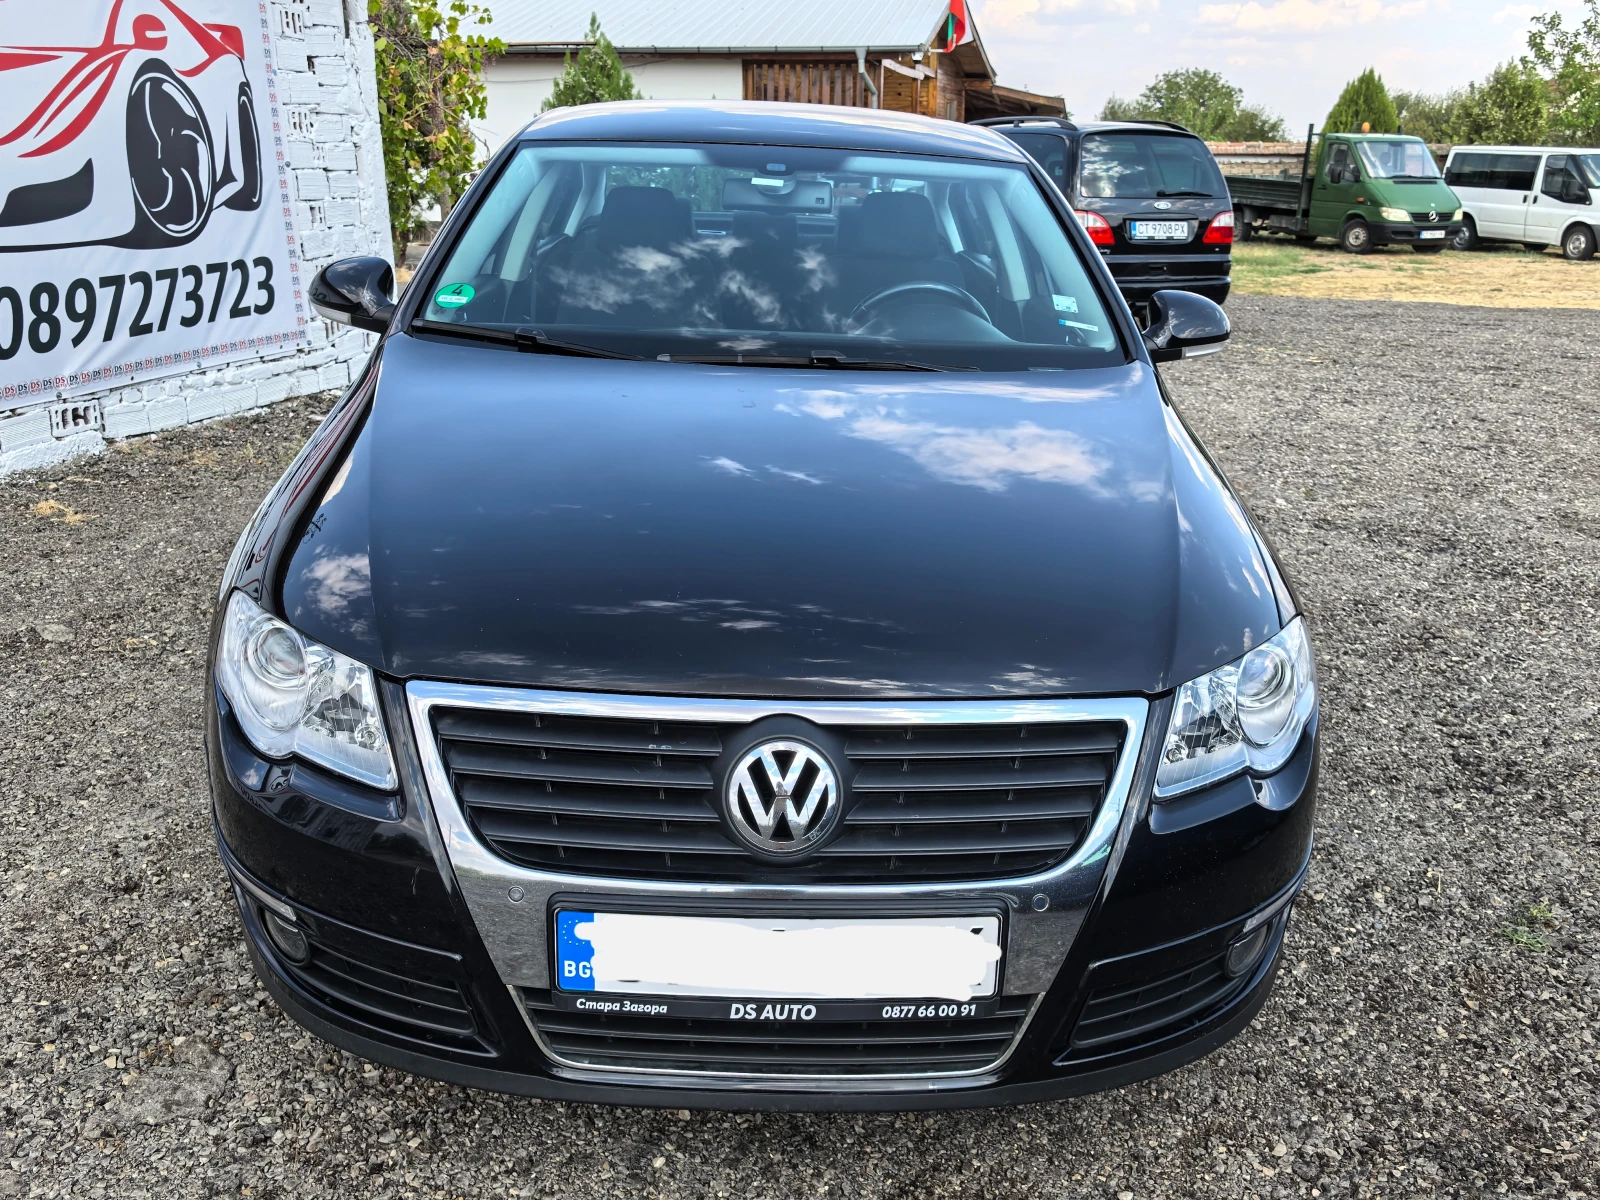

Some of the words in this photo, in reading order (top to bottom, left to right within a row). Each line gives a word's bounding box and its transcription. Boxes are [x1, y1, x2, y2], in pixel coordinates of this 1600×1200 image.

[1138, 223, 1150, 234] CT
[1152, 223, 1173, 234] 9708
[1174, 223, 1185, 234] PX
[451, 284, 463, 296] 4
[0, 256, 275, 360] 0897273723
[564, 960, 591, 978] BG
[576, 999, 620, 1012] Стара
[622, 1001, 668, 1015] Загора
[730, 1004, 757, 1020] DS
[760, 1004, 816, 1020] AUTO
[882, 1006, 916, 1018] 0877
[918, 1005, 936, 1017] 66
[938, 1005, 957, 1016] 00
[960, 1004, 976, 1016] 91
